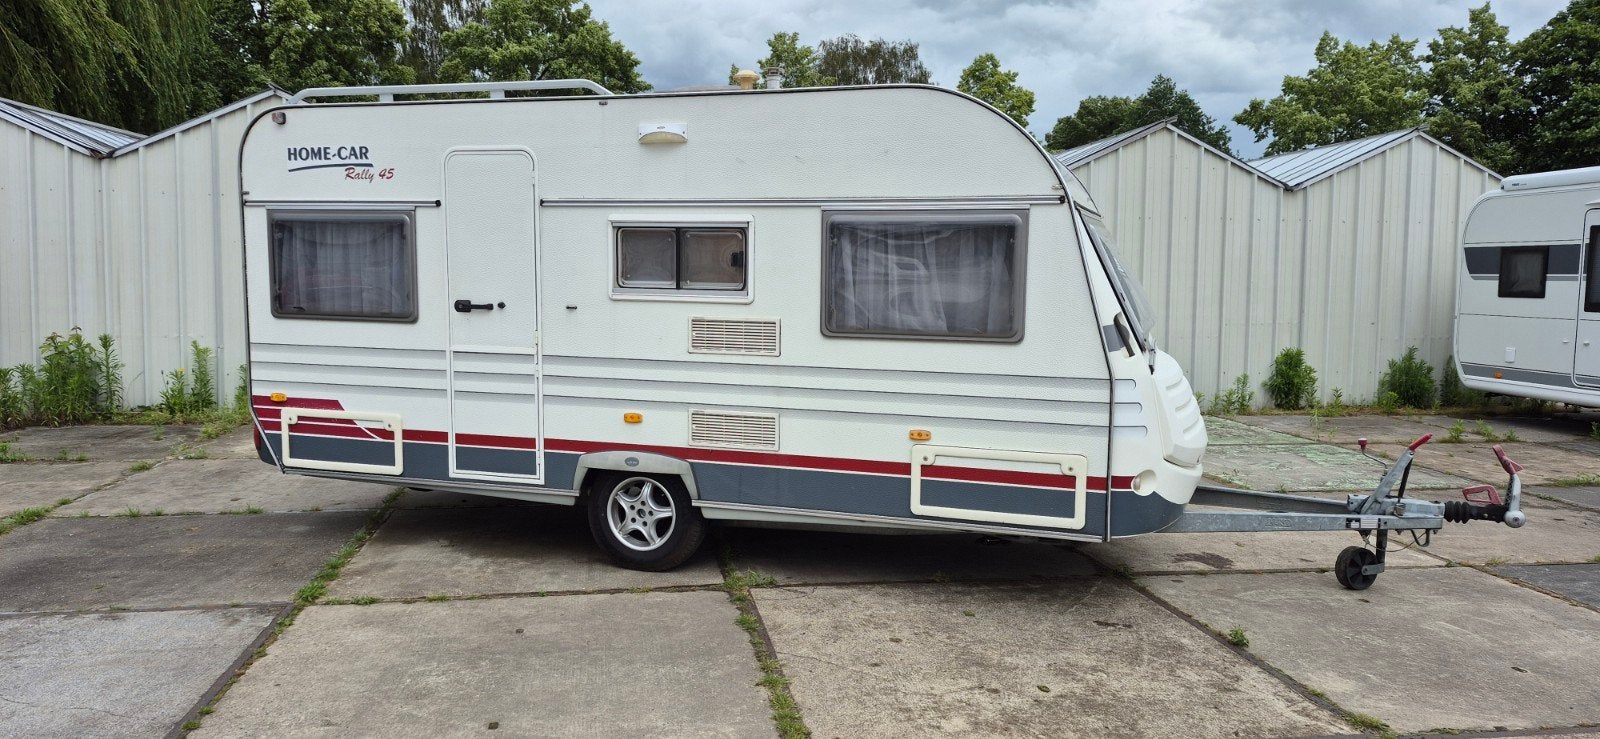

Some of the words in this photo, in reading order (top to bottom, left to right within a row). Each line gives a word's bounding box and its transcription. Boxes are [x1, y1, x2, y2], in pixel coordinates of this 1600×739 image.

[287, 146, 369, 161] HOME-CAR
[344, 167, 375, 183] Rally
[378, 168, 395, 180] 45
